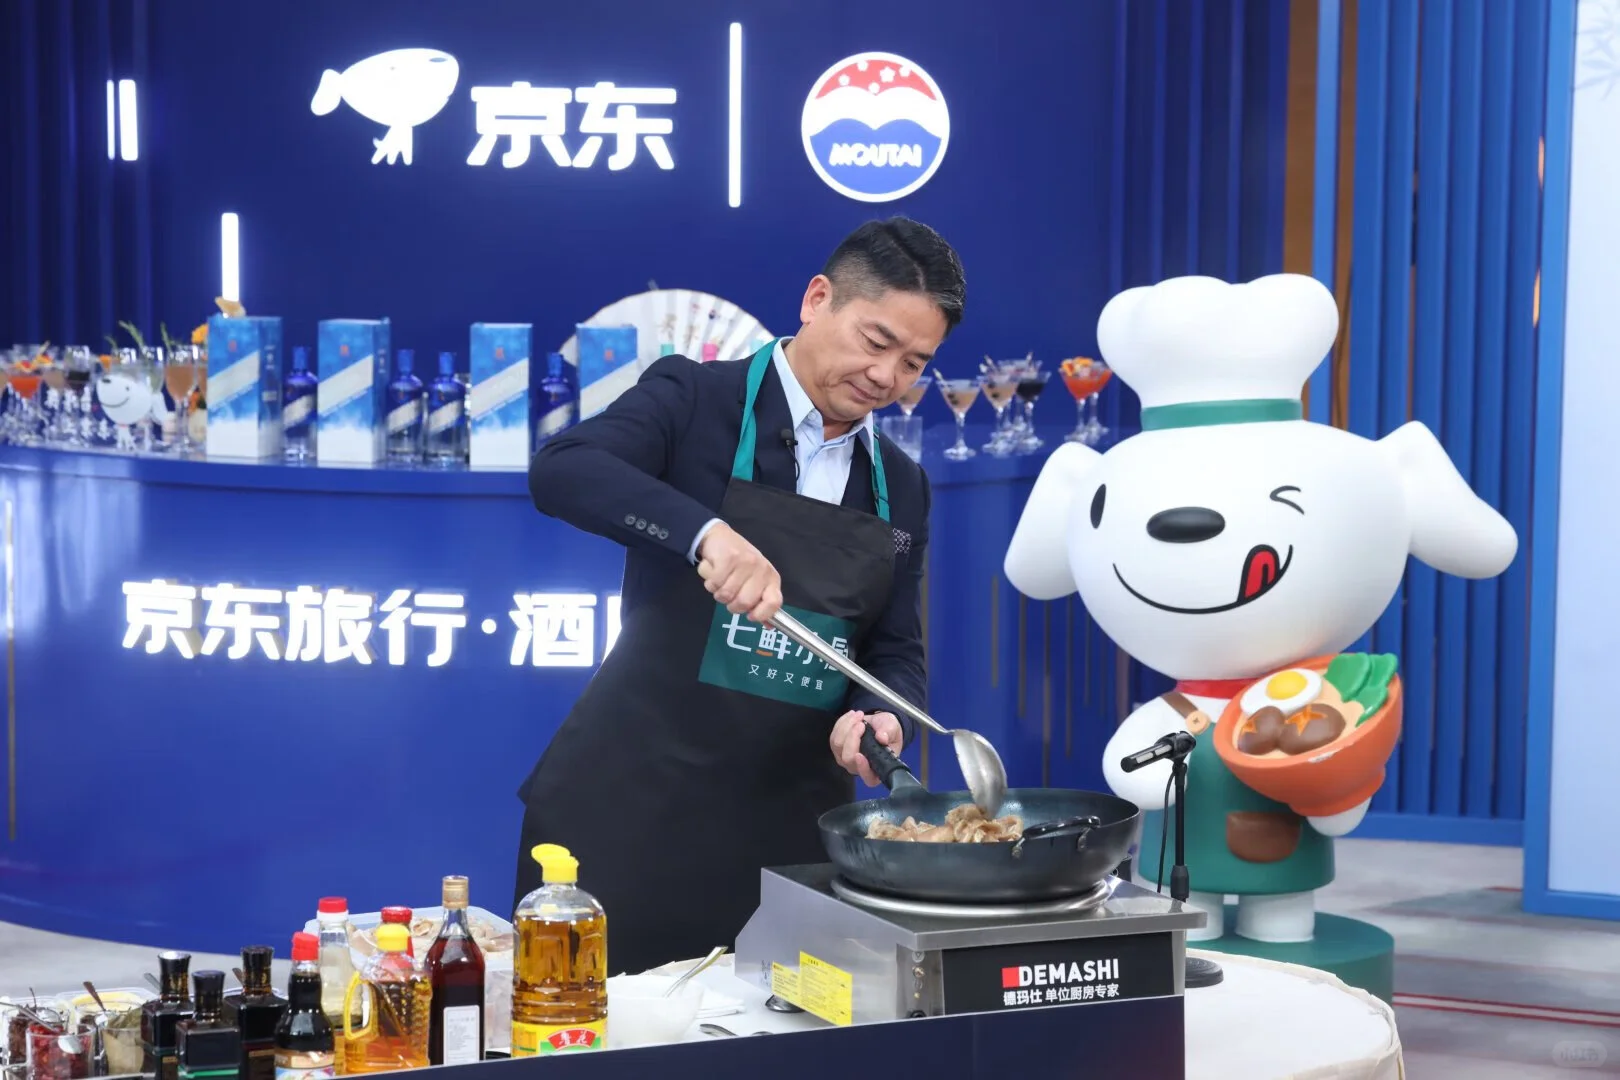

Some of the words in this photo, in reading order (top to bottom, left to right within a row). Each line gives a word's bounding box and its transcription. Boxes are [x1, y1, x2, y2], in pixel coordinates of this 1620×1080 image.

[466, 81, 678, 171] 京东
[828, 142, 922, 168] MOUTAI
[121, 579, 621, 668] 京东旅行·酒
[747, 663, 824, 691] 又好又便宜
[1018, 958, 1120, 987] DEMASHI
[1003, 988, 1043, 1006] 德玛仕
[1045, 982, 1120, 1003] 单位厨房专家
